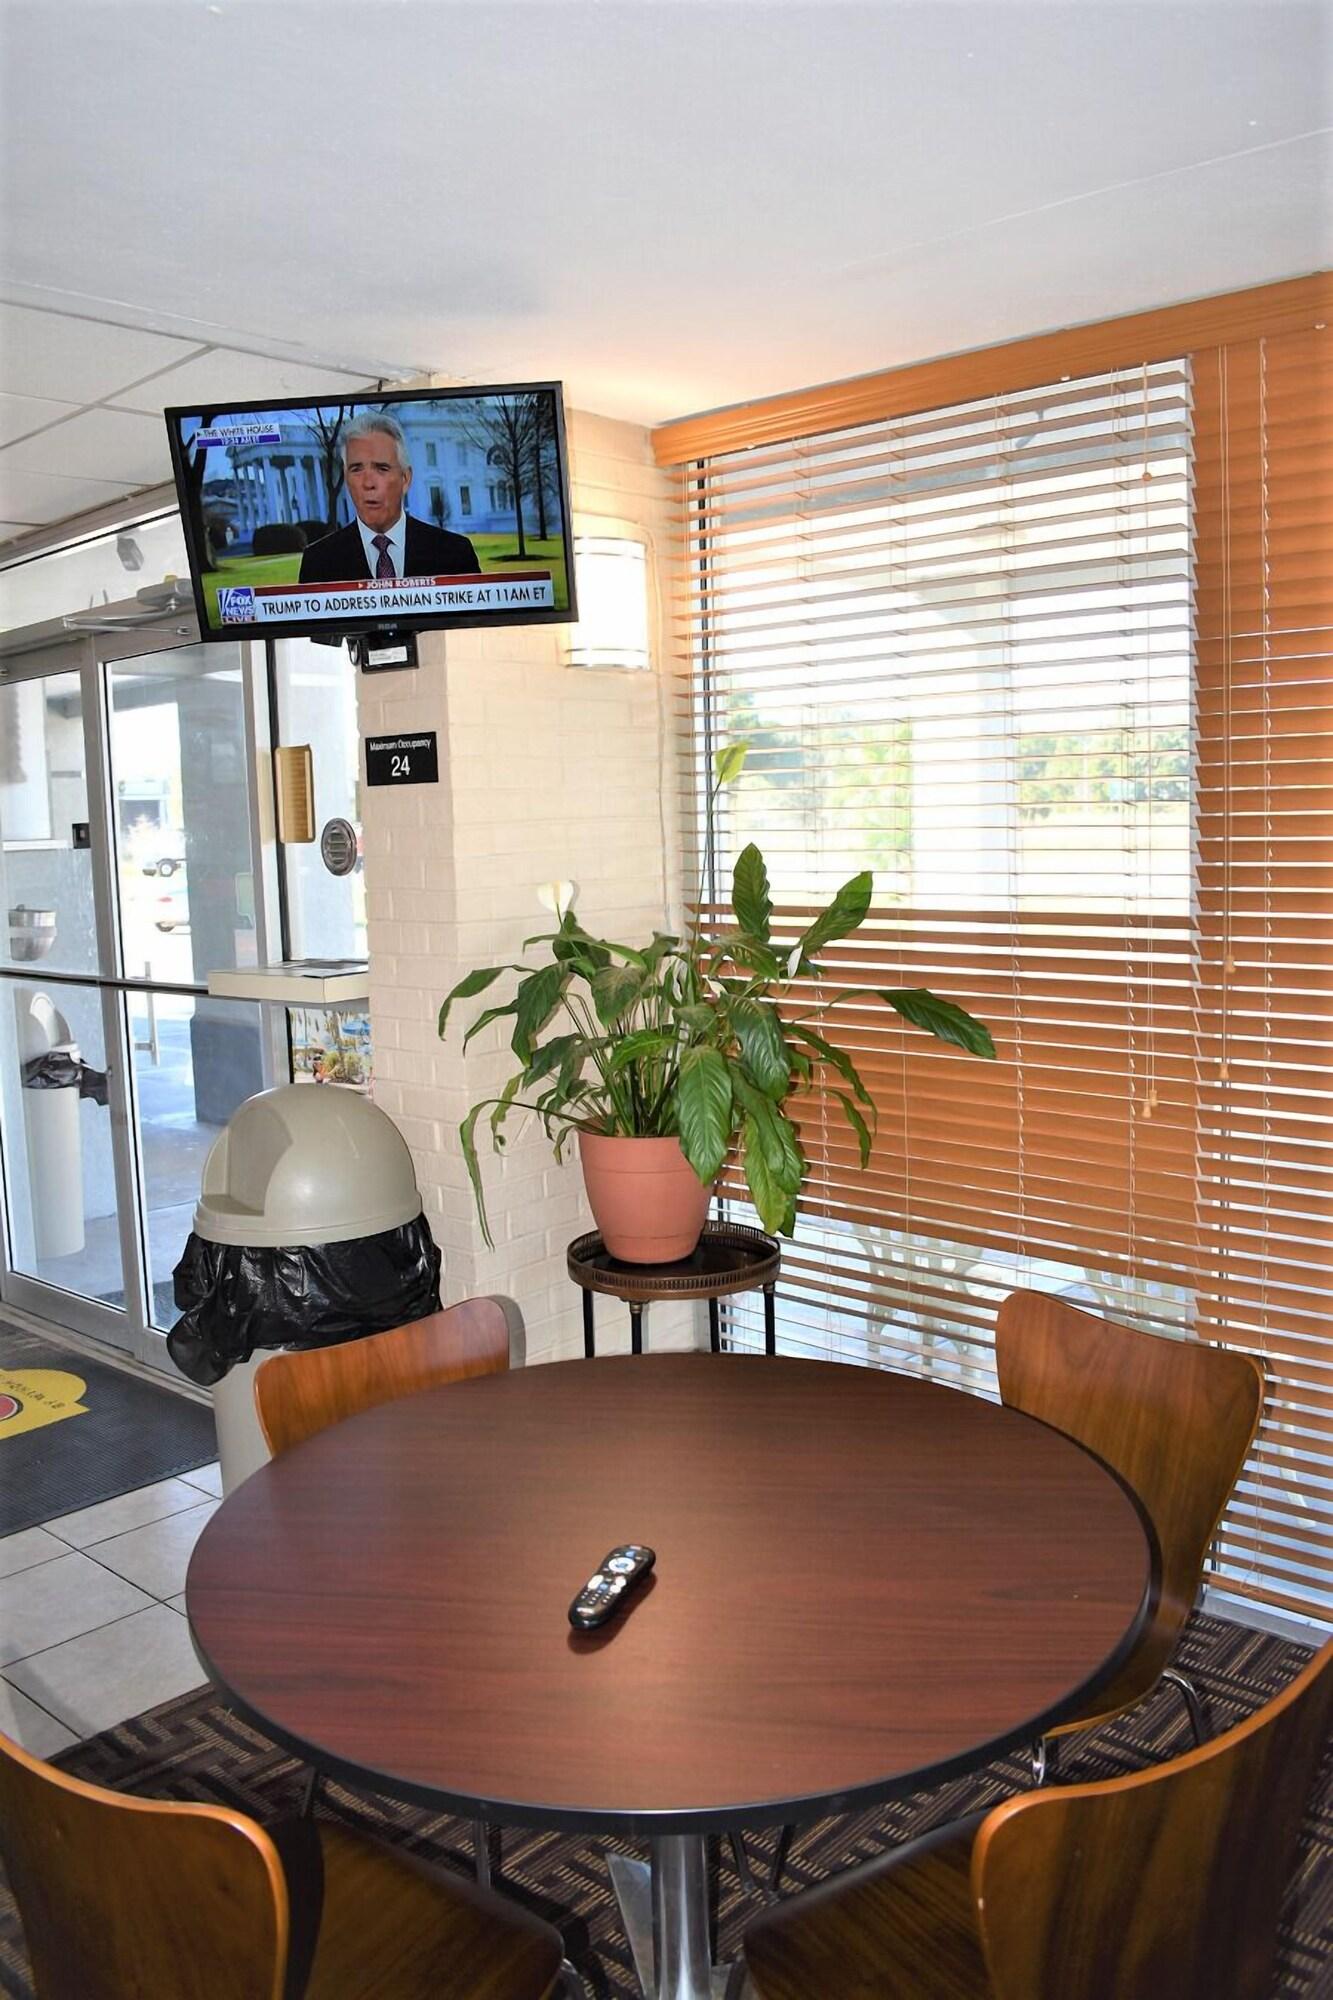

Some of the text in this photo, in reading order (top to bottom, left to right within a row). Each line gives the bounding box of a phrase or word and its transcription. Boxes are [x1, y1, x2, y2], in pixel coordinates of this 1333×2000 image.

[205, 425, 274, 438] THE WHITE HOUSE
[367, 577, 436, 589] JOHN ROBERTS
[231, 594, 253, 606] FOX
[261, 587, 546, 615] TRUMP TO ADDRESS IRANIAN STRIKE AT 11AM ET
[226, 603, 254, 616] NEWS
[226, 616, 252, 624] LIVE
[369, 739, 431, 752] Maximum Occupancy
[391, 755, 411, 776] 24
